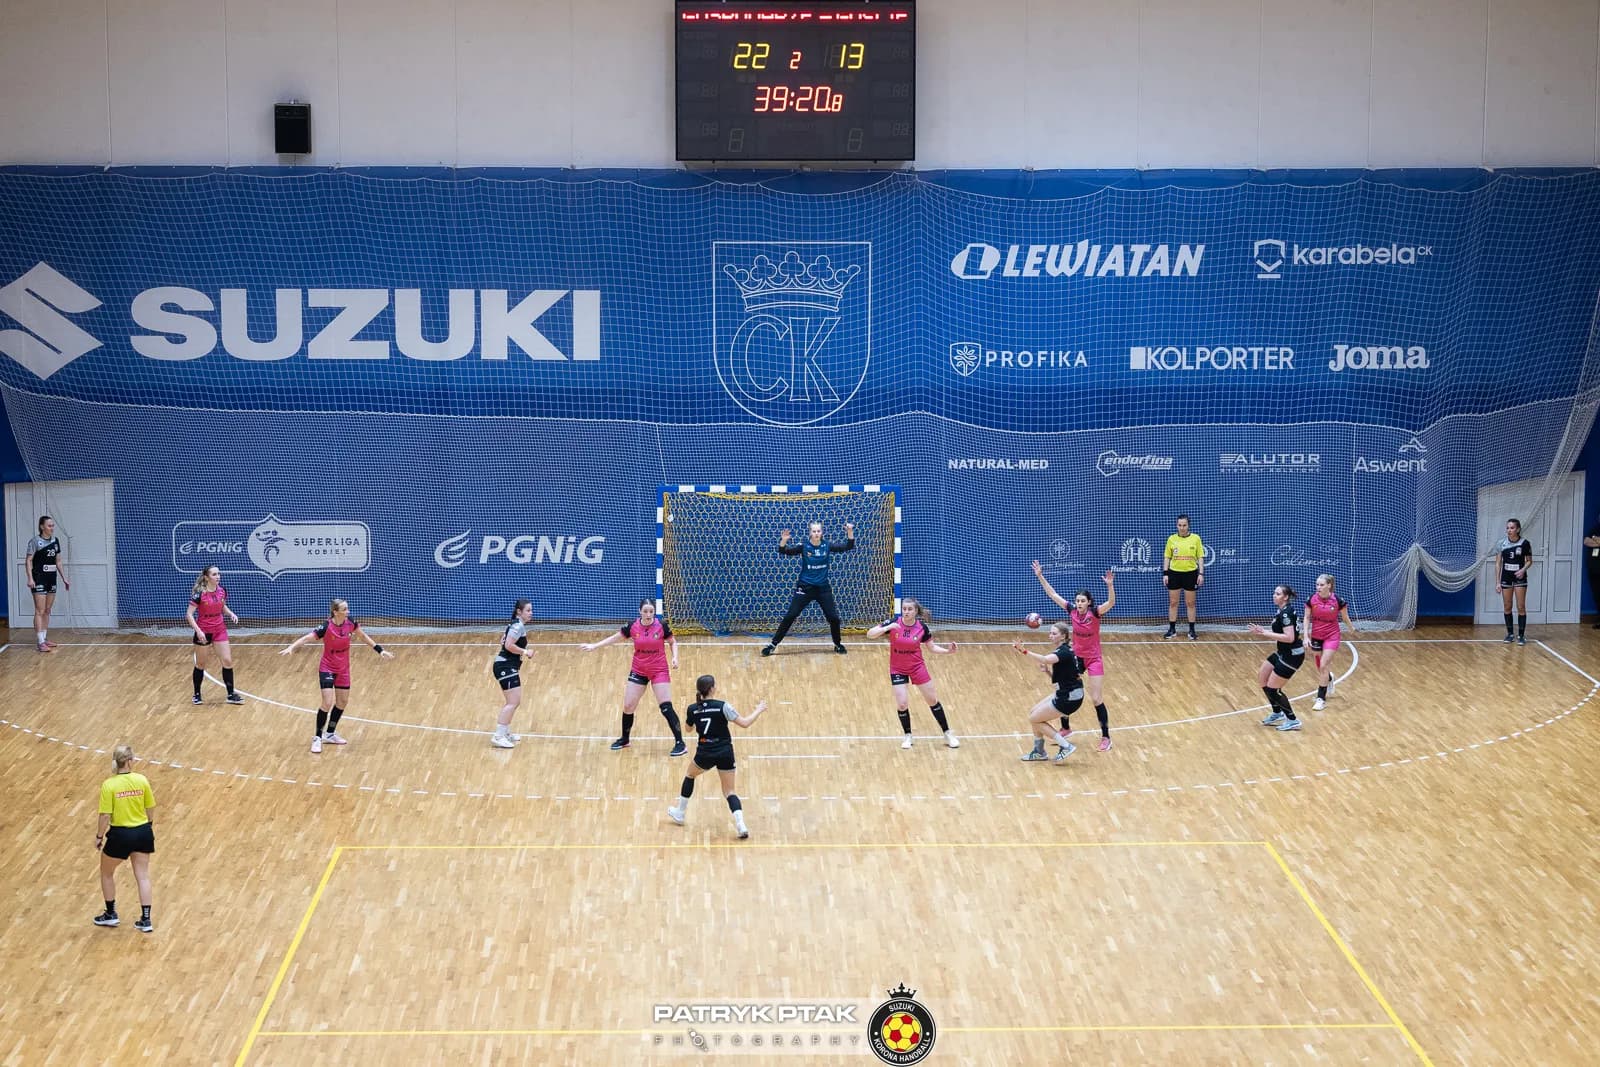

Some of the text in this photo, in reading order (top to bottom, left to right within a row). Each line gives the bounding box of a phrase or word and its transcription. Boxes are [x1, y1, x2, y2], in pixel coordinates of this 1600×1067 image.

[733, 43, 770, 69] 22
[790, 52, 801, 69] 2
[839, 43, 864, 69] 13
[1002, 239, 1205, 277] LEWIATAN
[130, 286, 601, 361] SUZUKI
[730, 314, 842, 402] CK
[986, 350, 1089, 368] PROFIKA
[1146, 347, 1295, 370] KOLPORTER
[948, 458, 1049, 470] NATURAL-MED
[1231, 453, 1320, 464] ALUTOR
[1354, 456, 1428, 473] Aswent
[197, 542, 243, 553] PGNiG
[293, 537, 360, 546] SUPERLIGA
[479, 535, 605, 564] PGNiG
[700, 717, 712, 735] 7
